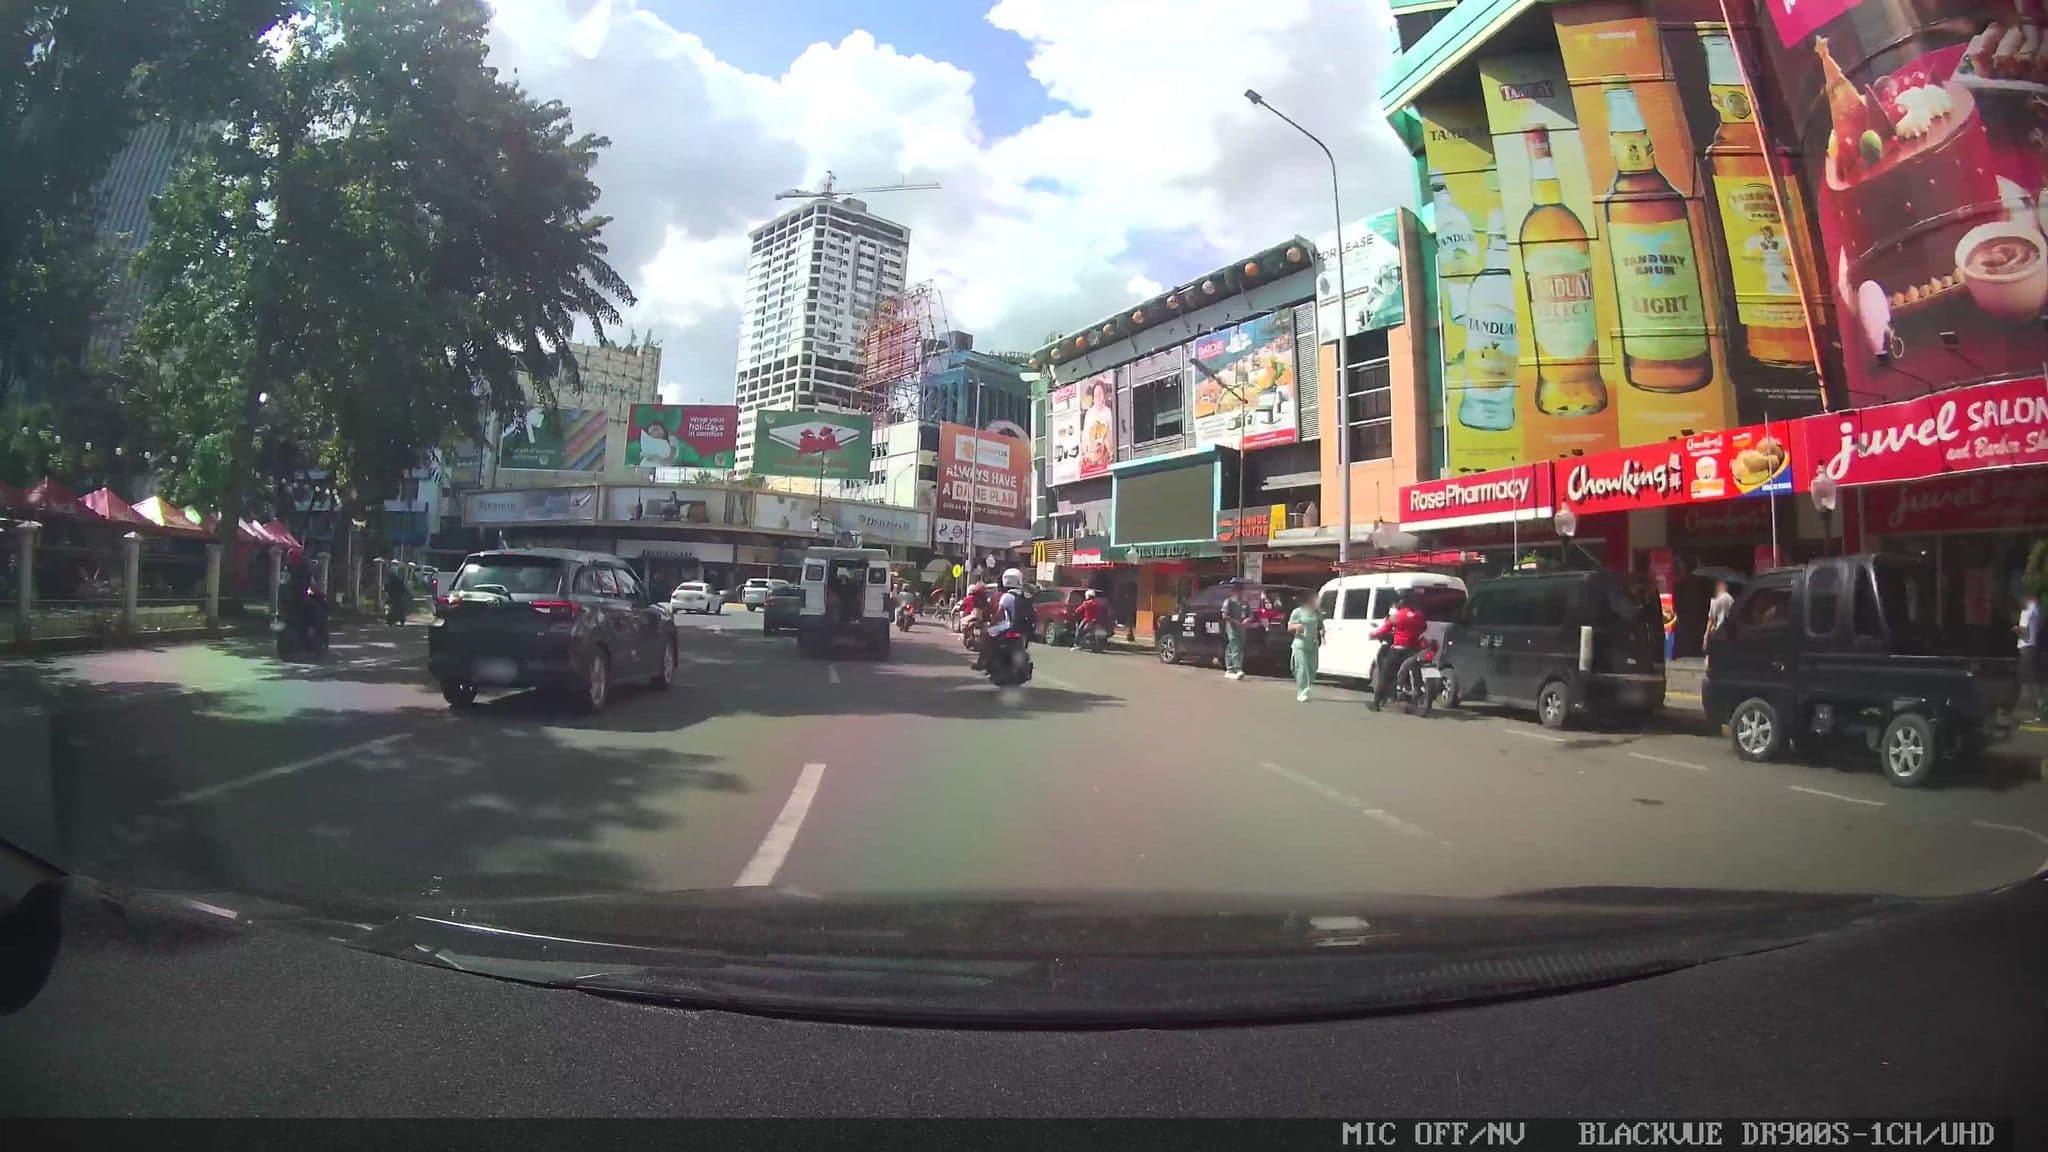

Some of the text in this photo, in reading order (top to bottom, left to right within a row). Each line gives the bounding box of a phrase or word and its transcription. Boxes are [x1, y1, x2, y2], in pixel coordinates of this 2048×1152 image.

[688, 422, 725, 433] holidays
[1826, 397, 2048, 481] juvel SALON
[991, 472, 1017, 488] HAVE
[1567, 458, 1668, 501] Chowking
[942, 482, 952, 496] A
